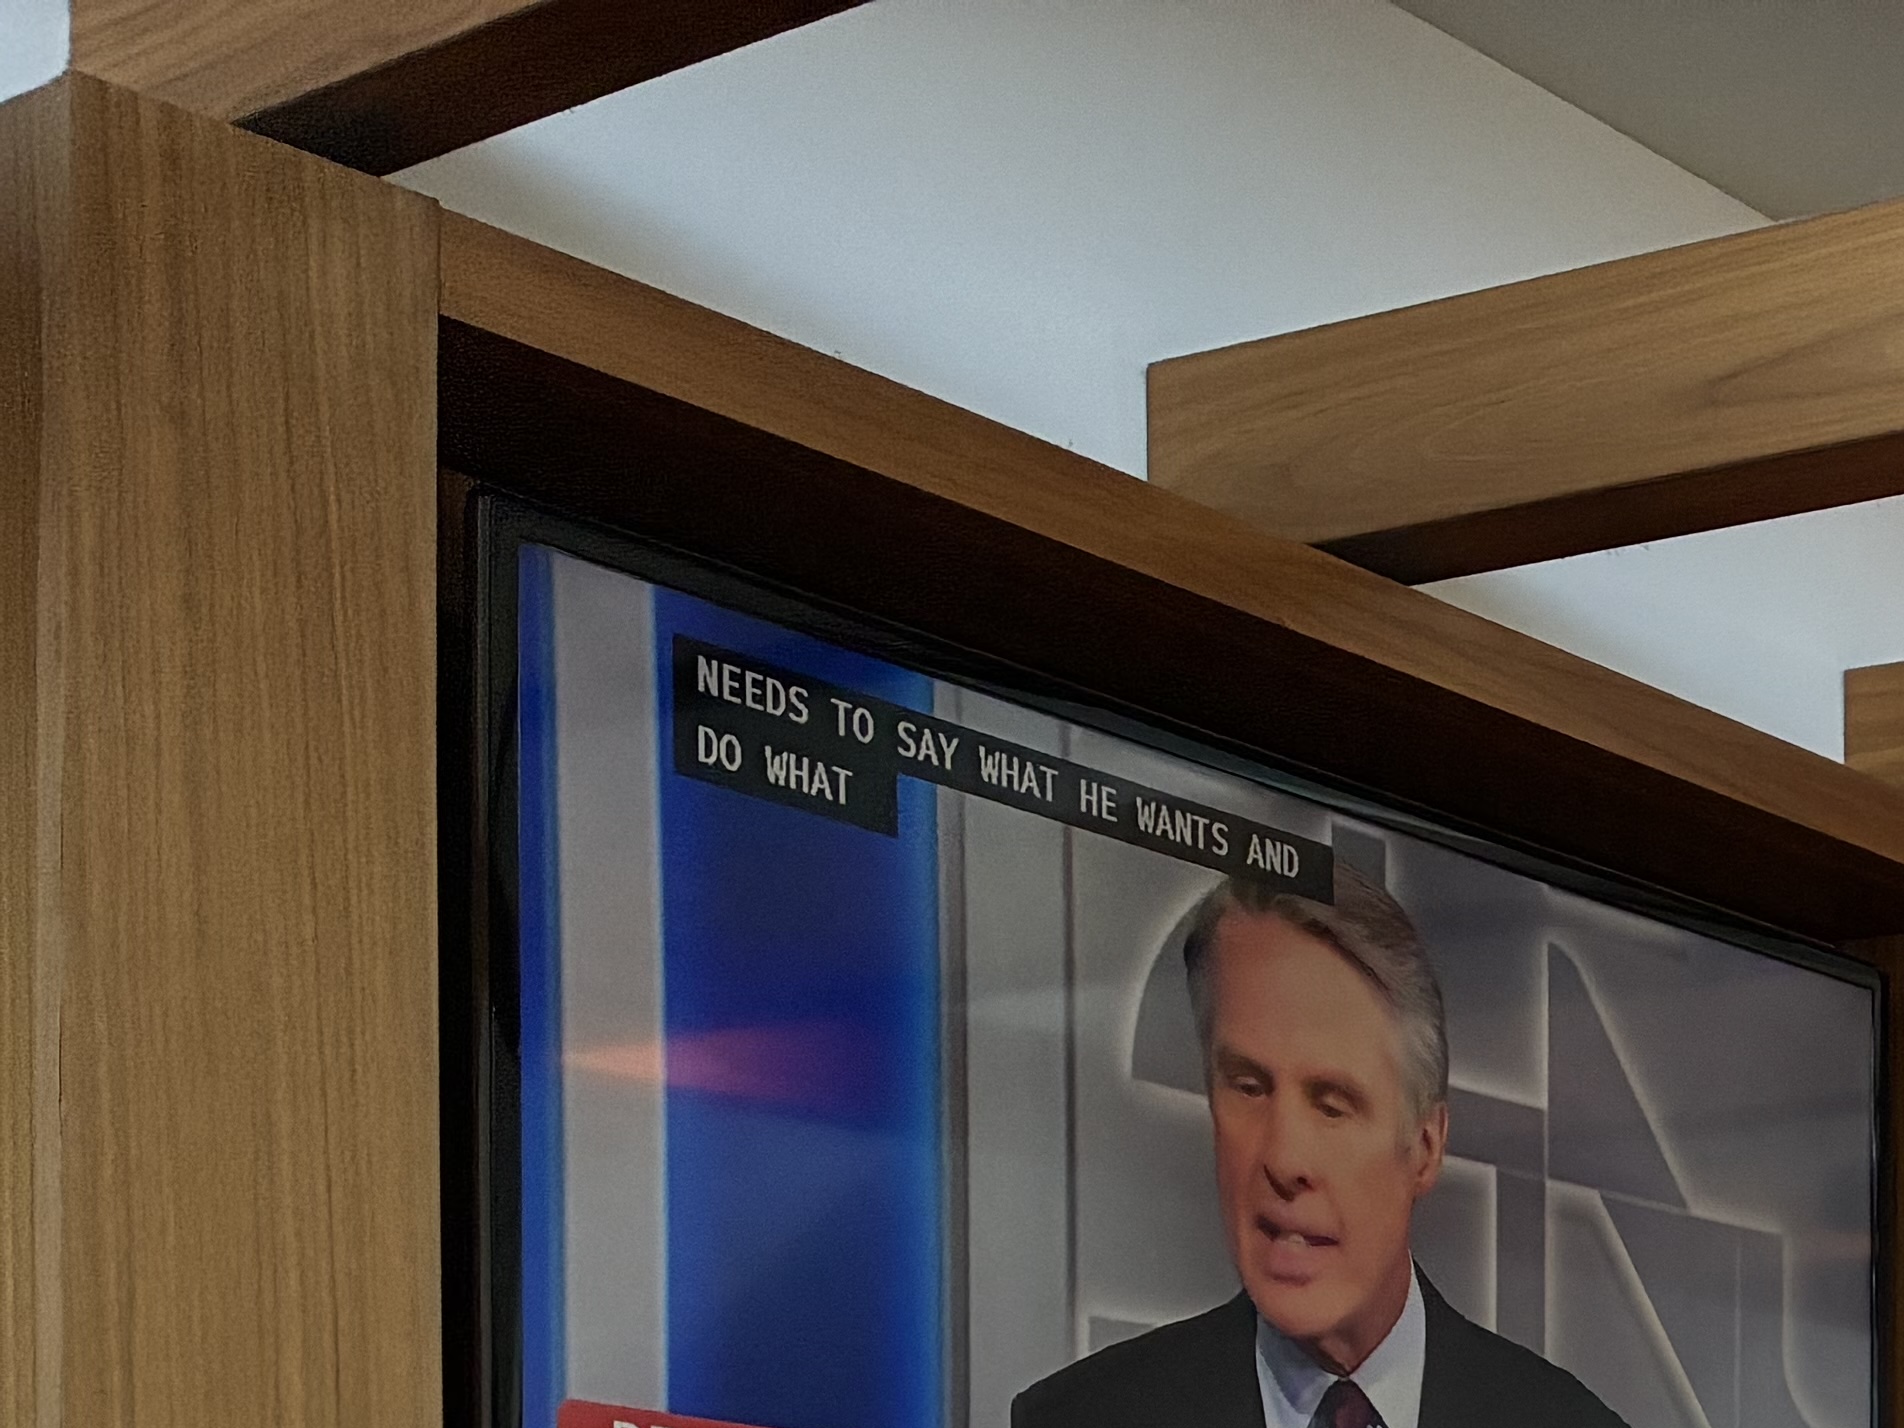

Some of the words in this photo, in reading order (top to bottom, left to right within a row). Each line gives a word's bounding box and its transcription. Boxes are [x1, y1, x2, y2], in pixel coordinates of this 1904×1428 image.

[698, 725, 742, 772] DO
[764, 745, 853, 805] WHAT
[698, 655, 809, 725] NEEDS
[831, 697, 875, 745] TO
[897, 720, 960, 771] SAY
[978, 745, 1059, 803] WHAT
[1079, 778, 1118, 823] HE
[1135, 796, 1229, 857] WANTS
[1246, 833, 1300, 879] AND
